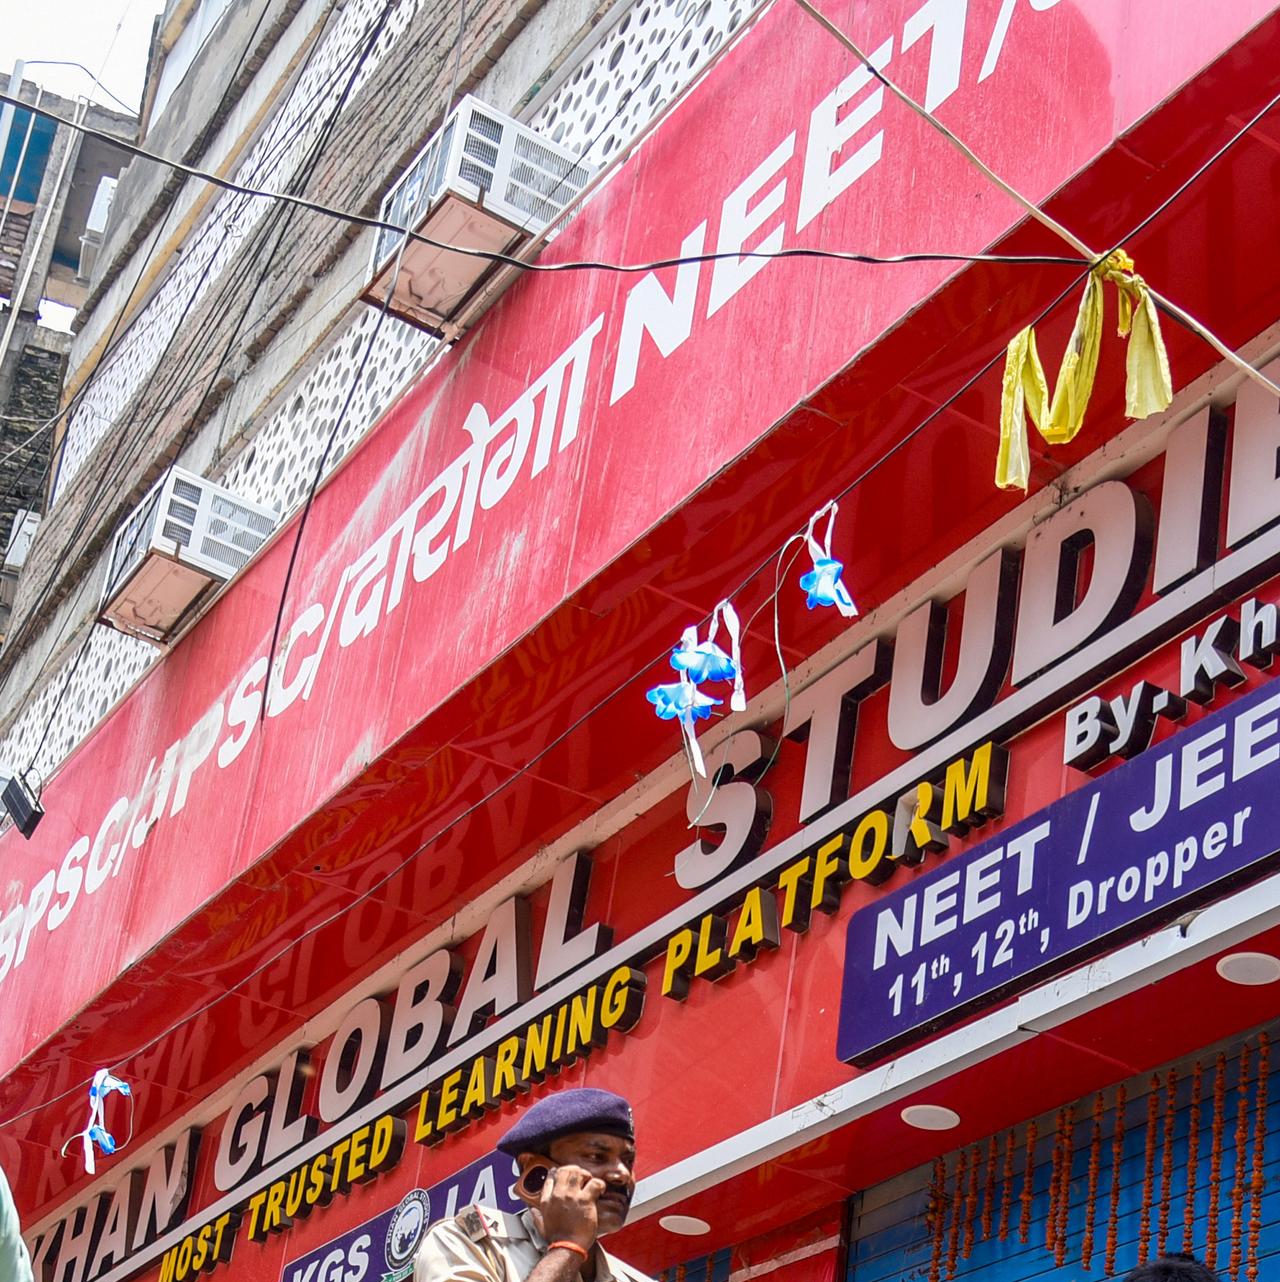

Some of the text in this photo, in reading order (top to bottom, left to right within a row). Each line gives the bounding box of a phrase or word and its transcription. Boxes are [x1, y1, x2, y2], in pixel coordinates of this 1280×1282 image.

[873, 821, 1050, 970] NEET
[1067, 806, 1252, 929] Dropper
[213, 852, 598, 1193] GLOBAL
[248, 1115, 394, 1240] TRUSTED
[415, 965, 632, 1141] LEARNING
[662, 742, 992, 997] PLATFORM
